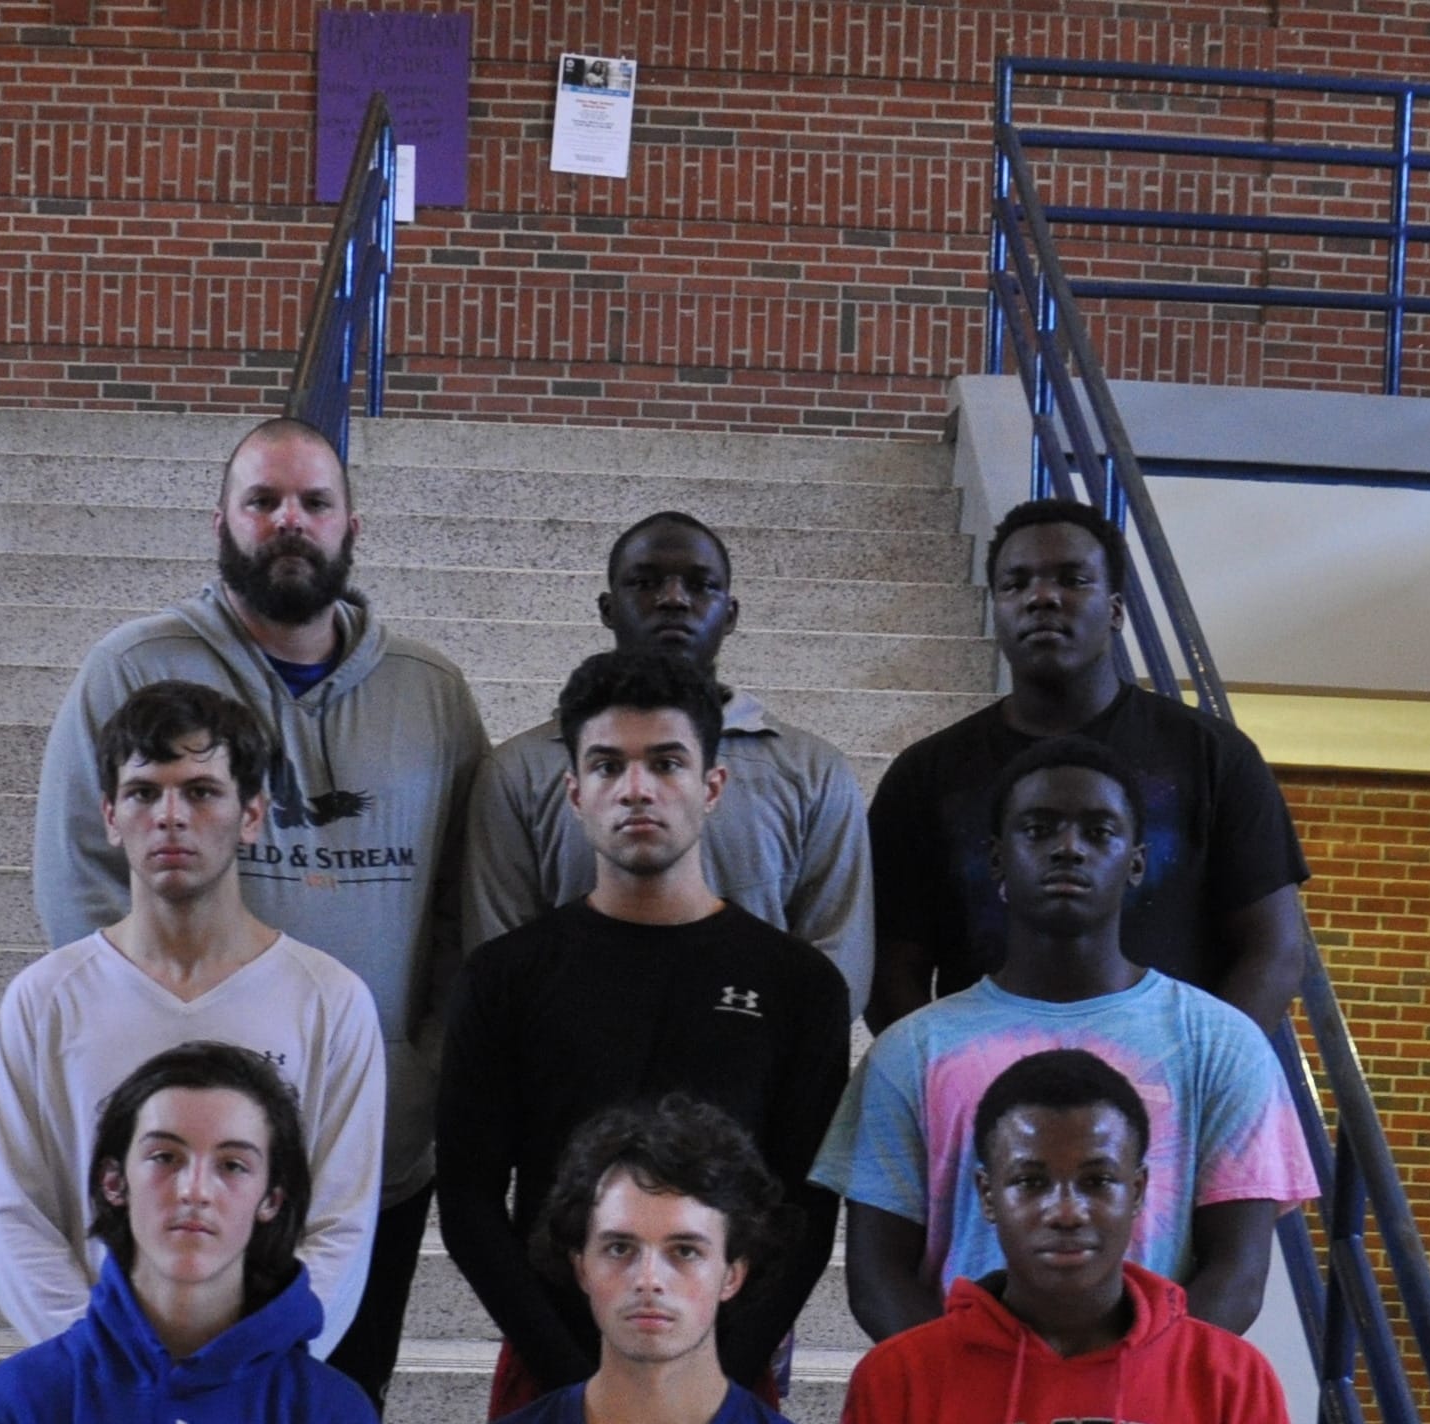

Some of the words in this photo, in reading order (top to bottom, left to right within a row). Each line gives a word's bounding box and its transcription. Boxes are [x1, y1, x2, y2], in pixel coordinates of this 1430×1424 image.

[238, 841, 282, 865] ELD
[289, 844, 308, 867] &
[315, 846, 416, 869] STREAM
